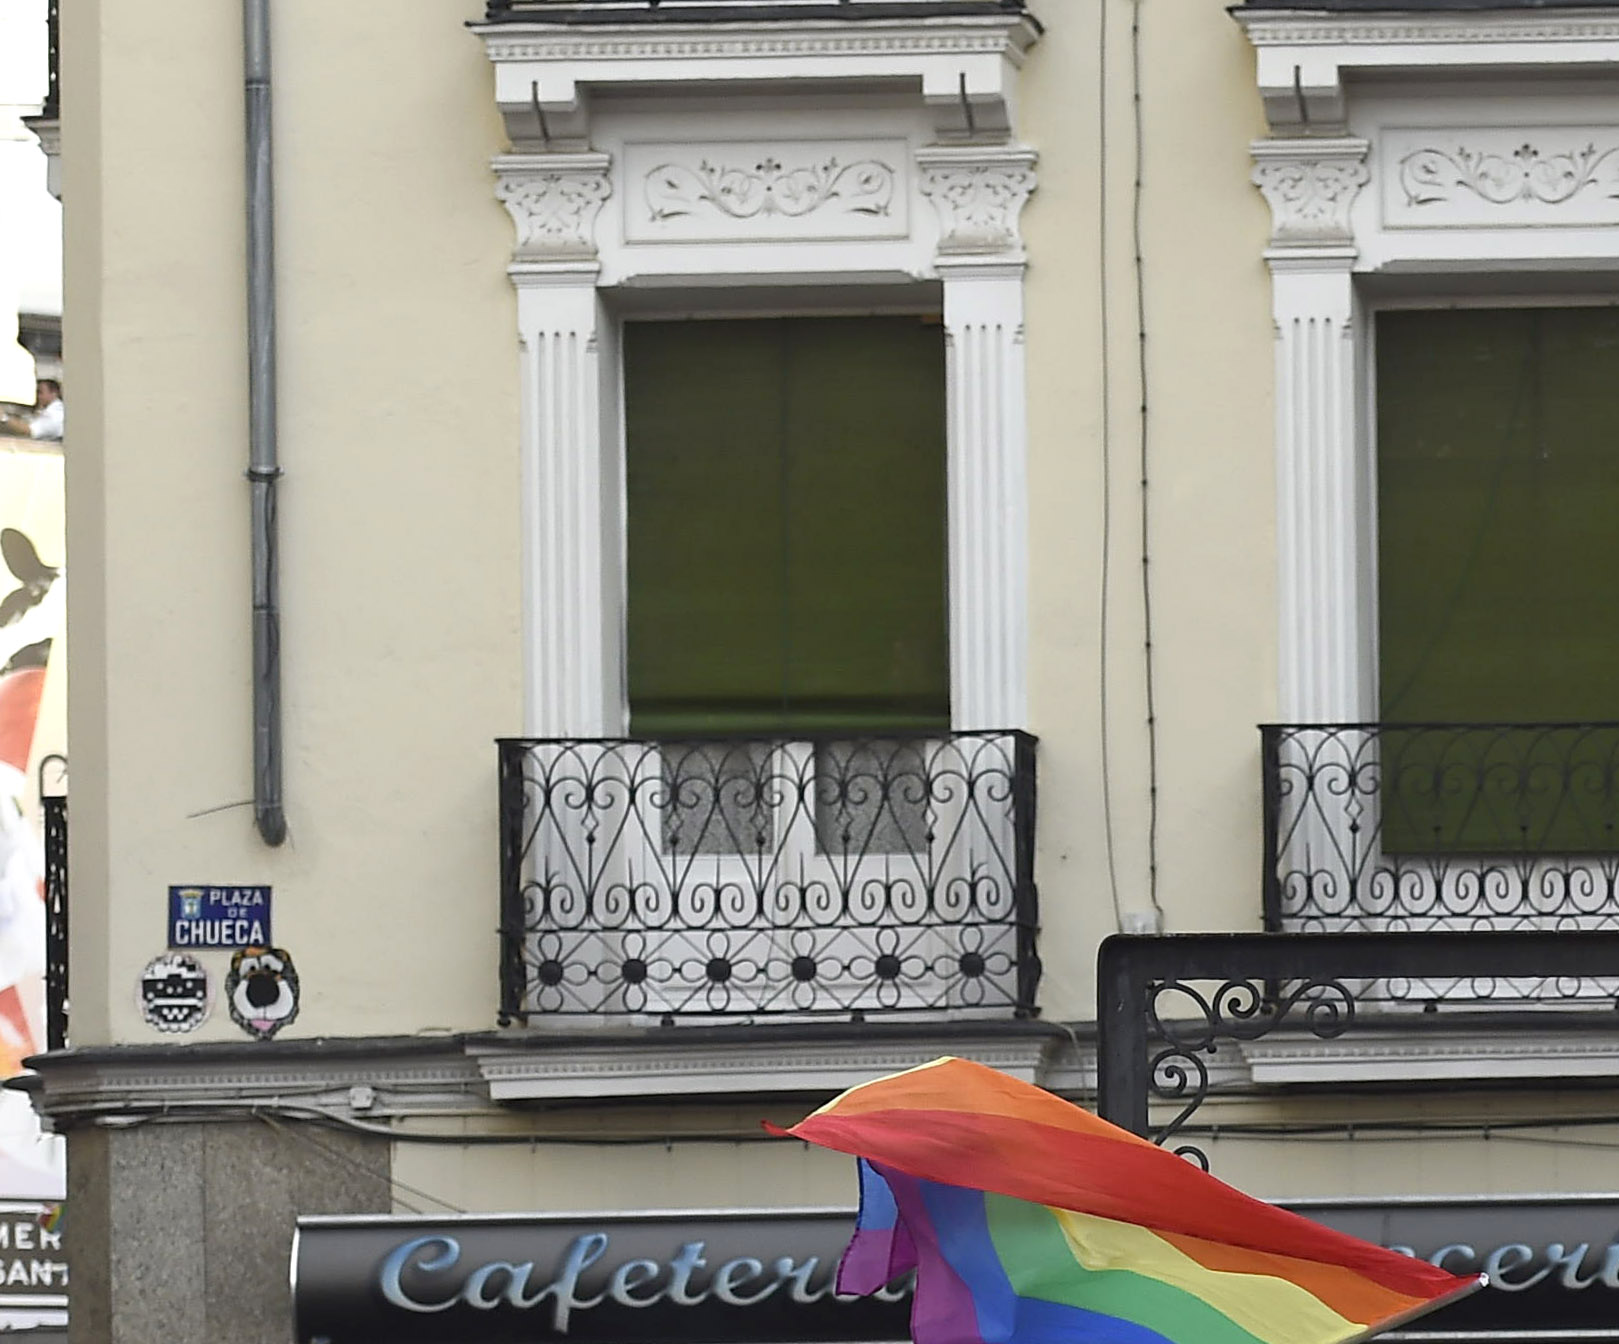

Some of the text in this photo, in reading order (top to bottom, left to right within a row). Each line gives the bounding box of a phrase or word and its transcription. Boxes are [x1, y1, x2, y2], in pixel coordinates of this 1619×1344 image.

[209, 888, 264, 907] PLAZA
[227, 907, 248, 918] DE
[174, 919, 265, 945] CHUECA
